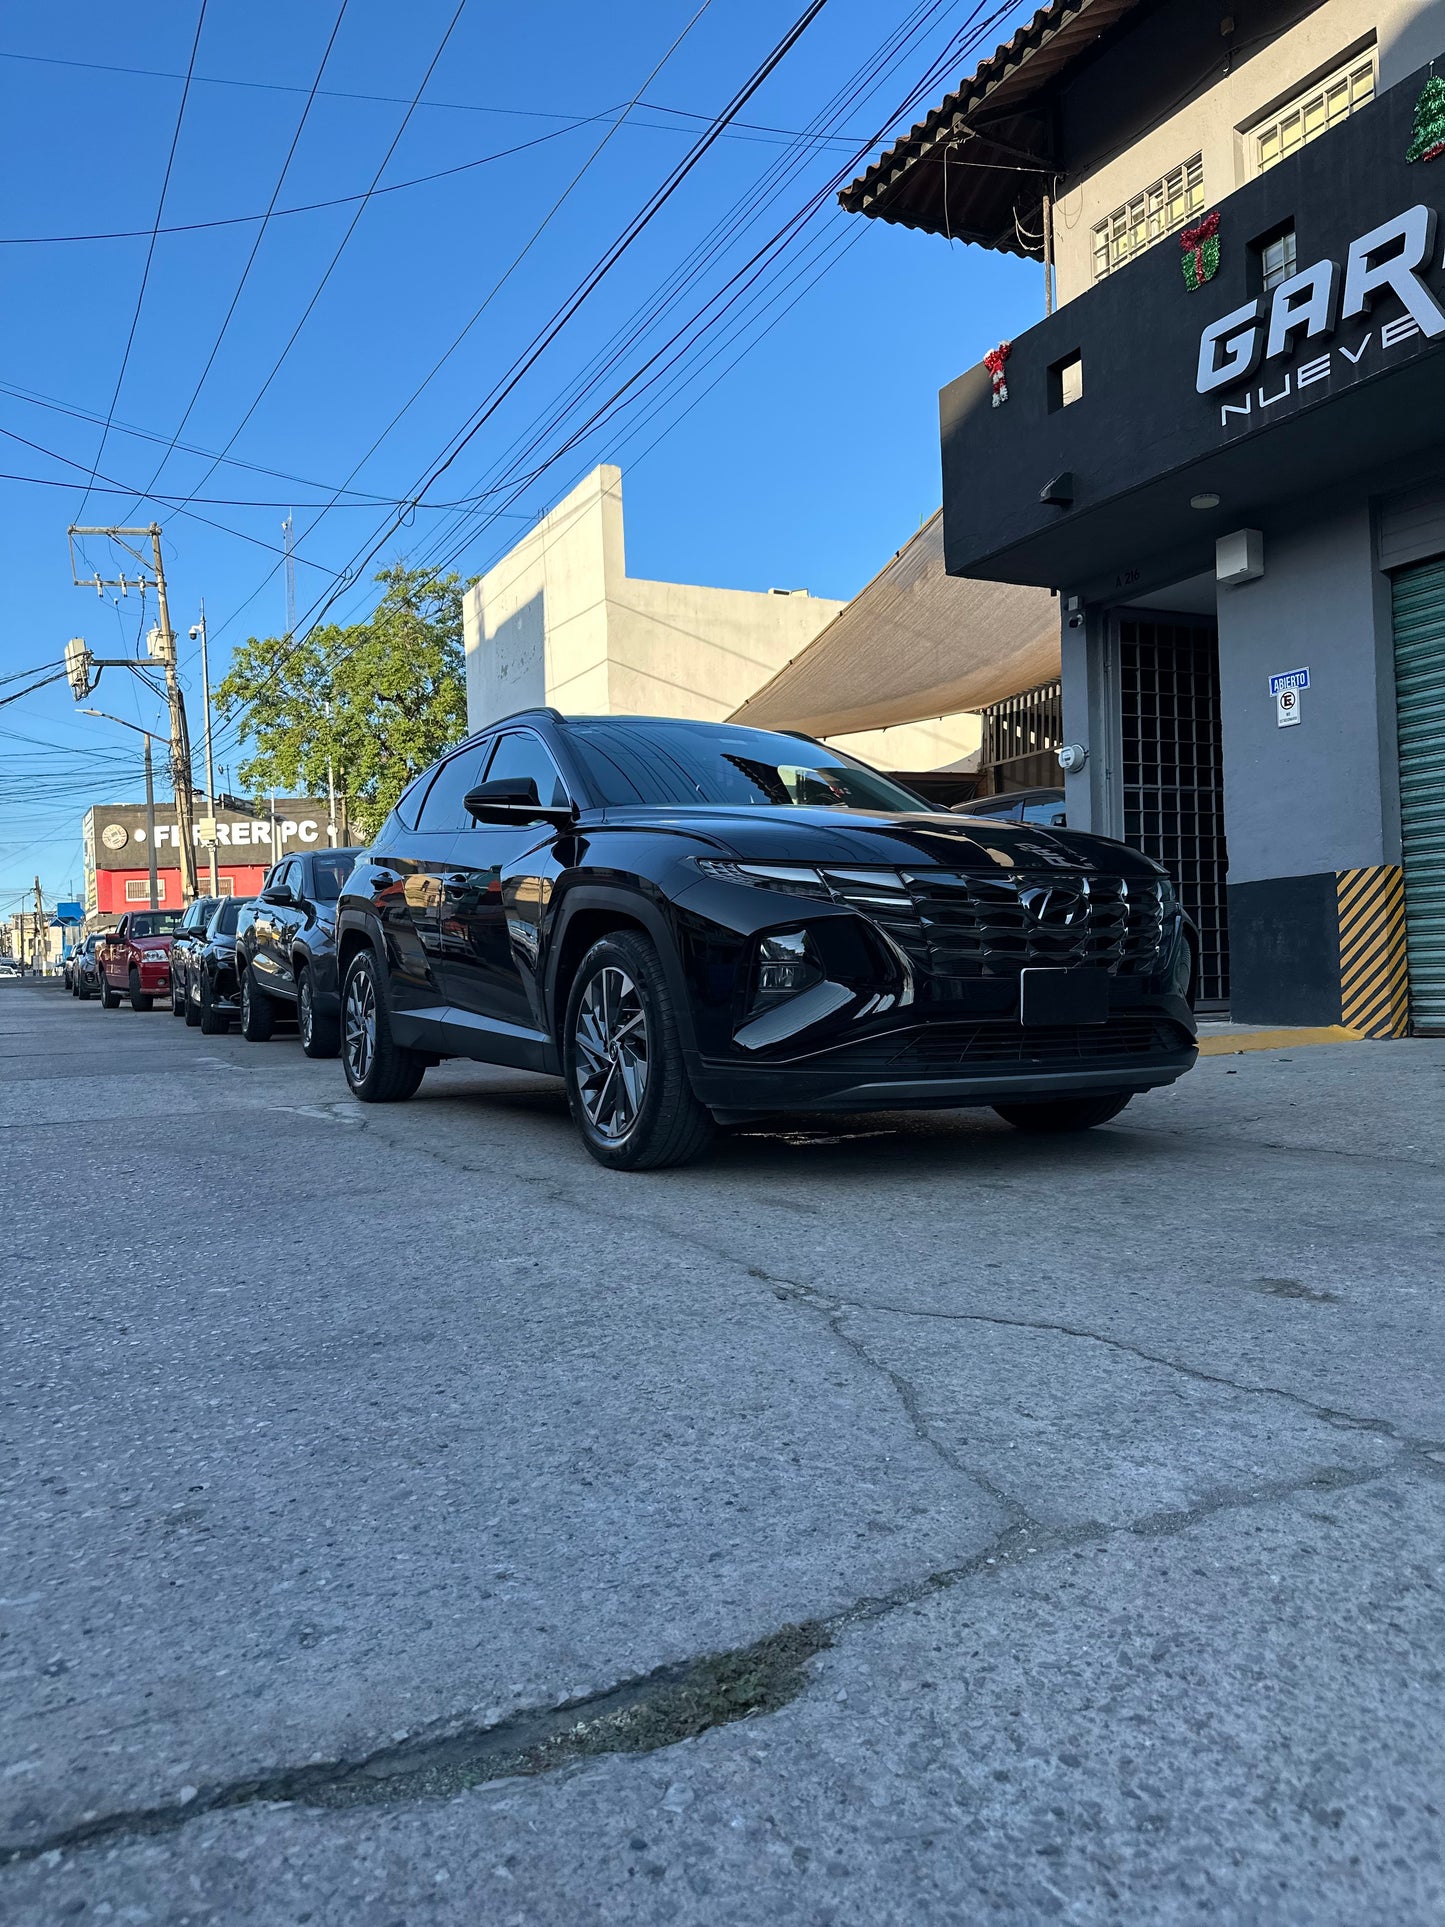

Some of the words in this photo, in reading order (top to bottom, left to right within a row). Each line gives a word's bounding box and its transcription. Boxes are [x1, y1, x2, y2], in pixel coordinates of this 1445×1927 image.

[1196, 204, 1445, 394] GAR
[1221, 313, 1420, 426] NUEVE
[1124, 568, 1140, 585] 216
[1274, 673, 1306, 692] ABIERTO
[281, 820, 319, 843] PC
